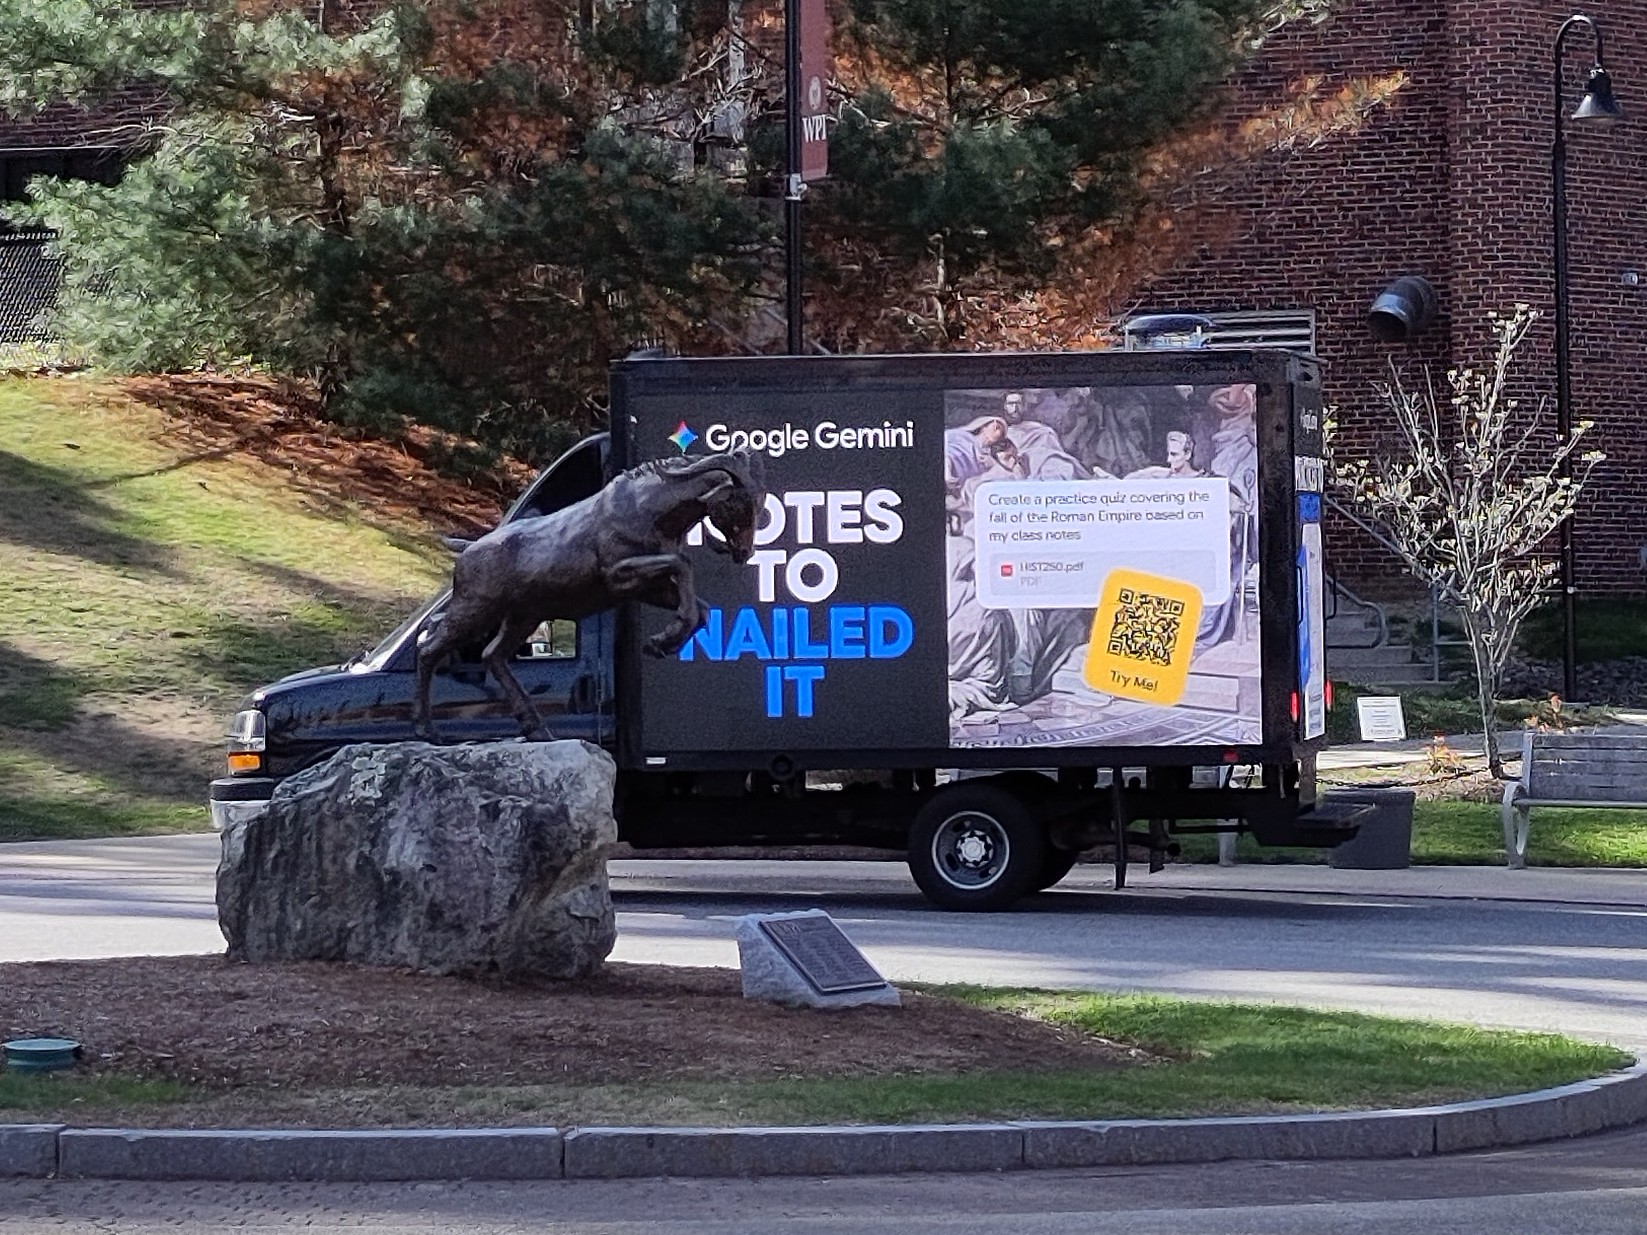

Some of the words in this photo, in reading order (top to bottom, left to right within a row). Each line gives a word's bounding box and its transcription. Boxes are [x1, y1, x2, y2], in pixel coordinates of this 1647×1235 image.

[802, 114, 827, 143] WPI
[706, 422, 809, 457] Google
[815, 421, 914, 449] Gemini
[988, 493, 1031, 506] Create
[1034, 496, 1042, 505] a
[1045, 493, 1098, 508] practice
[1100, 492, 1126, 506] quiz
[1130, 493, 1185, 506] covering
[1188, 490, 1210, 502] the
[989, 511, 1007, 524] fall
[1010, 511, 1022, 523] of
[1027, 511, 1049, 523] the
[1051, 510, 1095, 522] Roman
[1098, 509, 1142, 523] Empire
[1145, 509, 1184, 521] based
[1187, 511, 1204, 520] on
[989, 532, 1008, 544] my
[1011, 529, 1043, 541] class
[1045, 530, 1081, 541] notes
[747, 548, 839, 603] TO
[679, 606, 914, 661] NAILED
[767, 665, 825, 718] IT
[1110, 669, 1131, 688] Try
[1133, 676, 1159, 692] Me!
